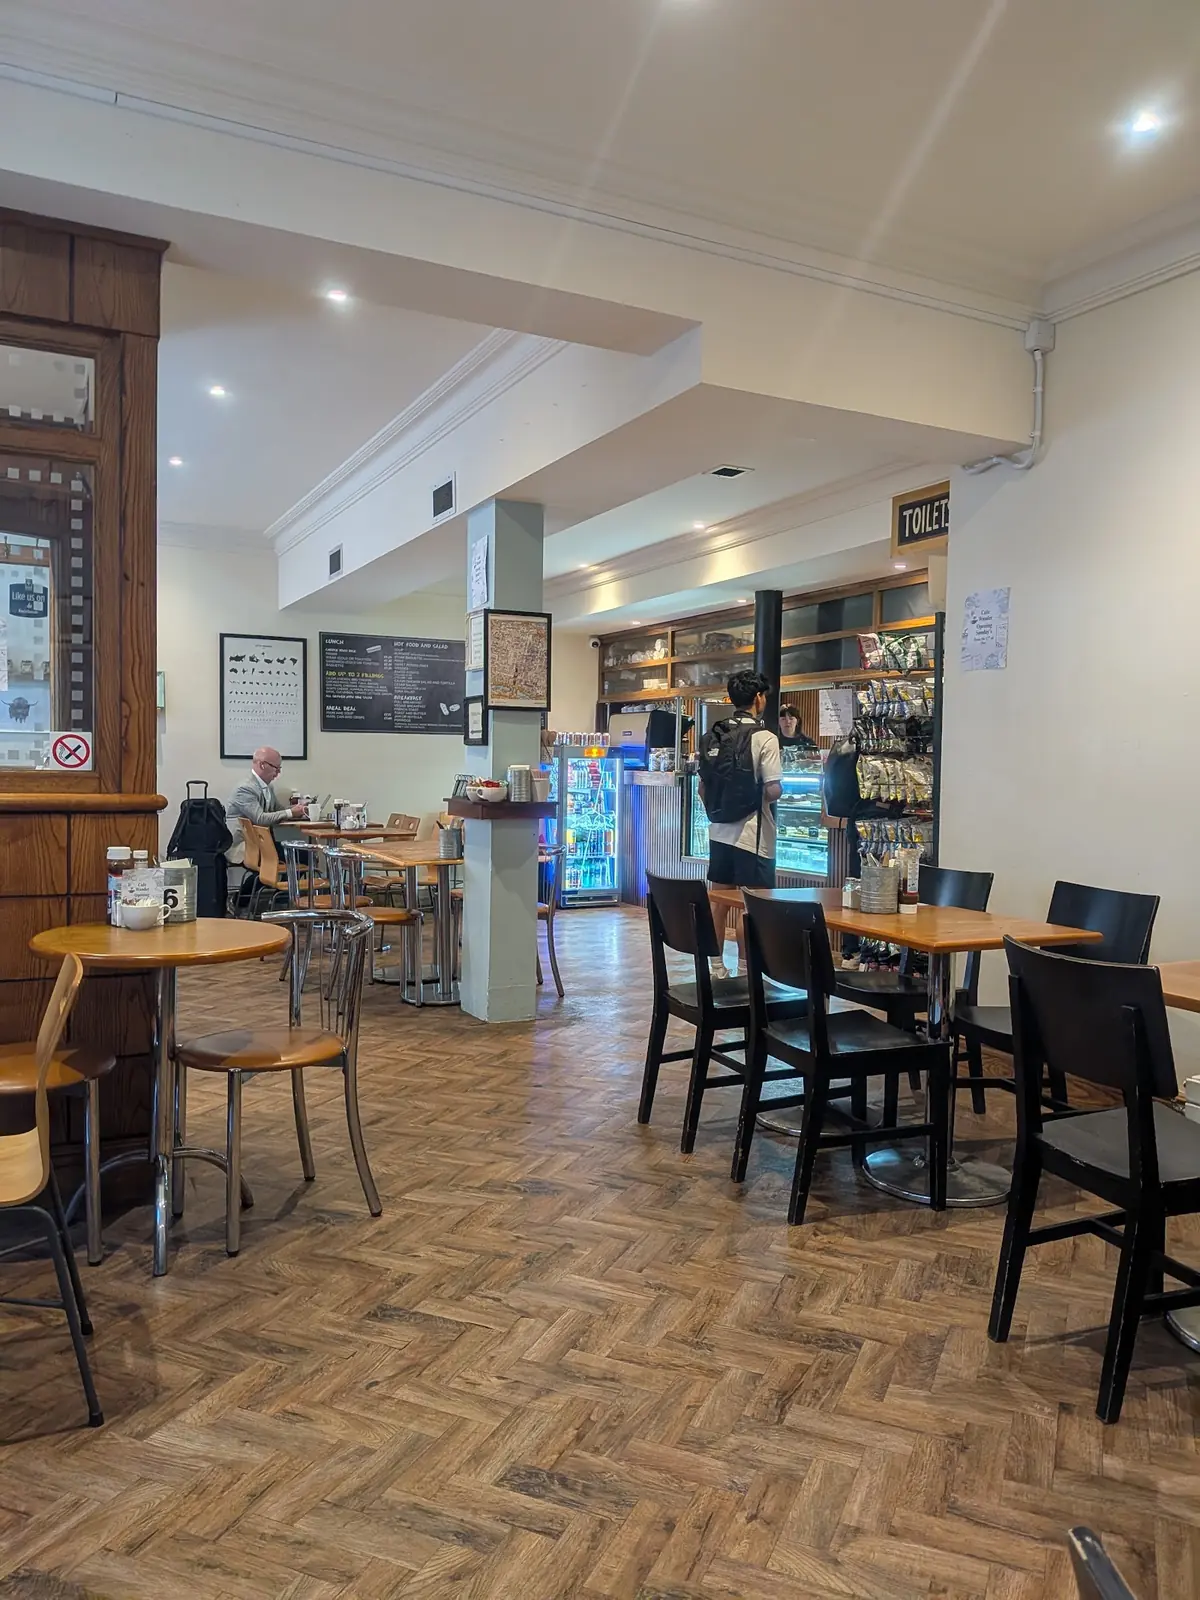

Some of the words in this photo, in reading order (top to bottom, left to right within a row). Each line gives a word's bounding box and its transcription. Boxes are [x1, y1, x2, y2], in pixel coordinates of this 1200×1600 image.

[12, 592, 25, 600] Like
[27, 593, 35, 602] us
[164, 889, 178, 908] 6
